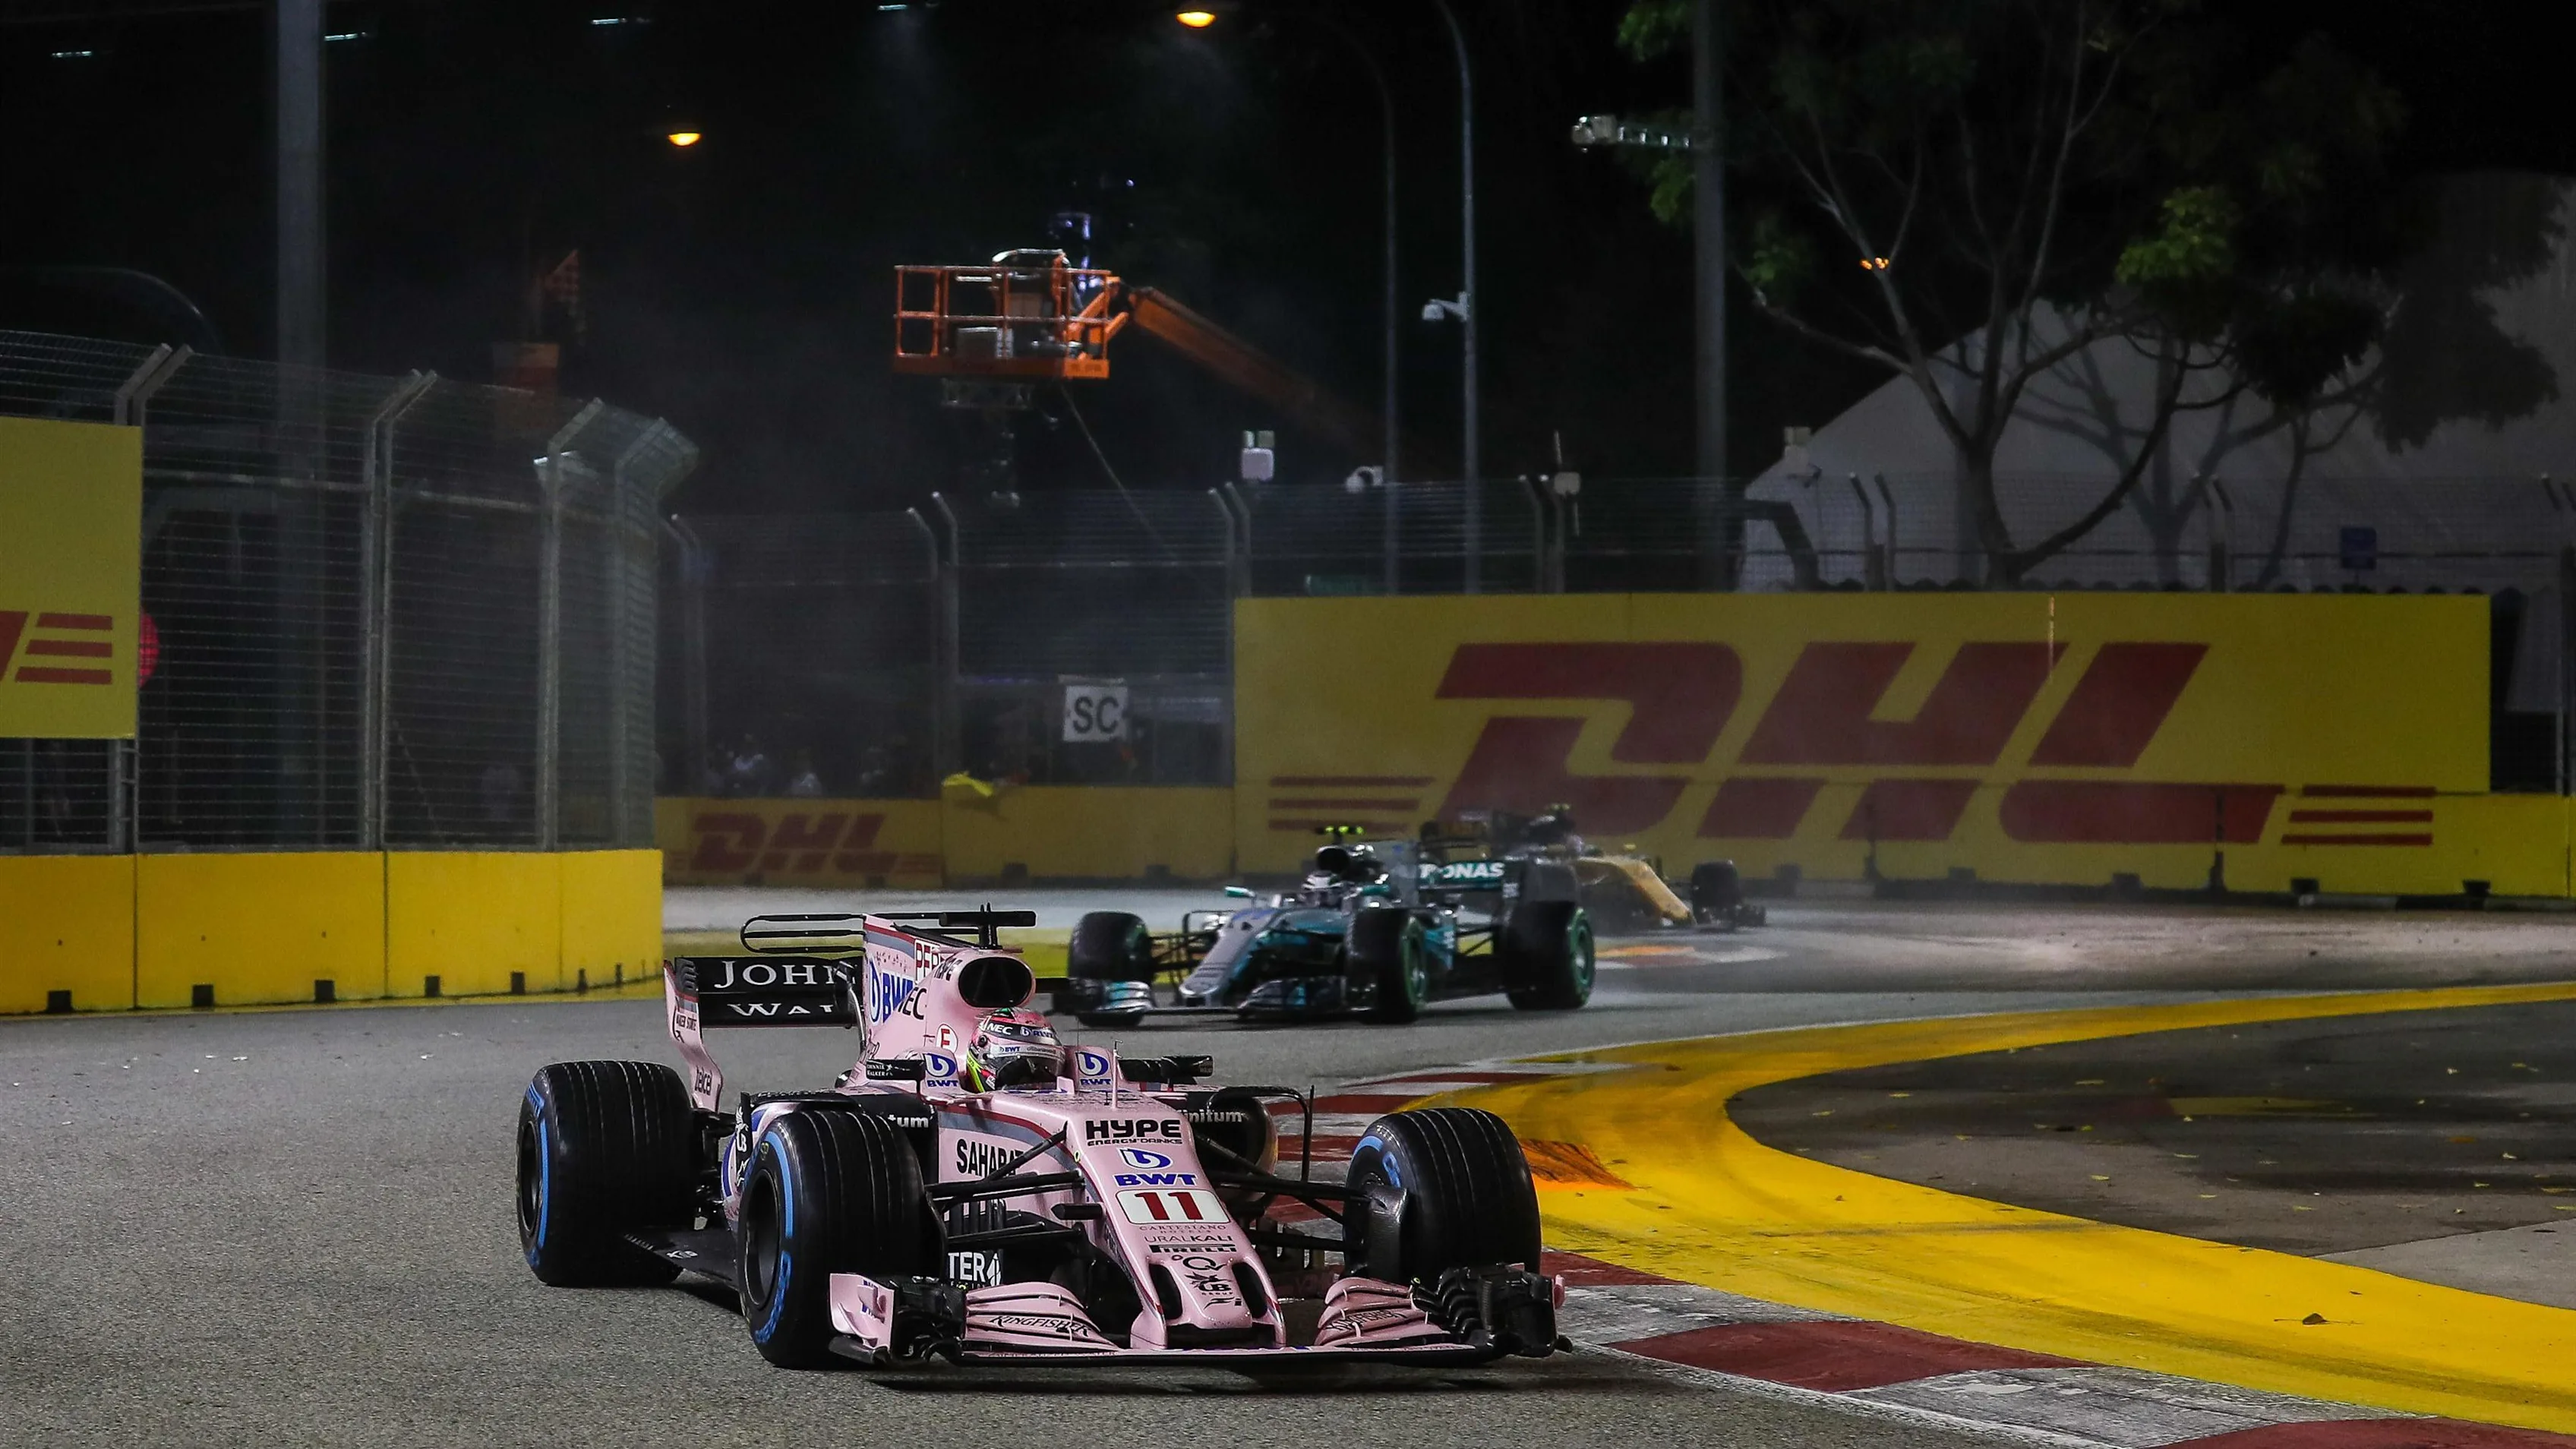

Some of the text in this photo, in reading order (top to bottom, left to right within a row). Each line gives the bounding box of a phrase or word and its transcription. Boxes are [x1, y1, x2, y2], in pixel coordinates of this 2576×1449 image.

[1073, 696, 1119, 734] SC
[1433, 642, 2285, 844] DHL
[691, 813, 899, 873] DHL
[987, 1022, 1013, 1035] NEC
[1086, 1119, 1182, 1139] HYPE
[1088, 1138, 1137, 1147] ENERGY
[1114, 1174, 1197, 1186] BWT
[1135, 1192, 1204, 1220] 11
[1149, 1244, 1237, 1253] PIRELLI
